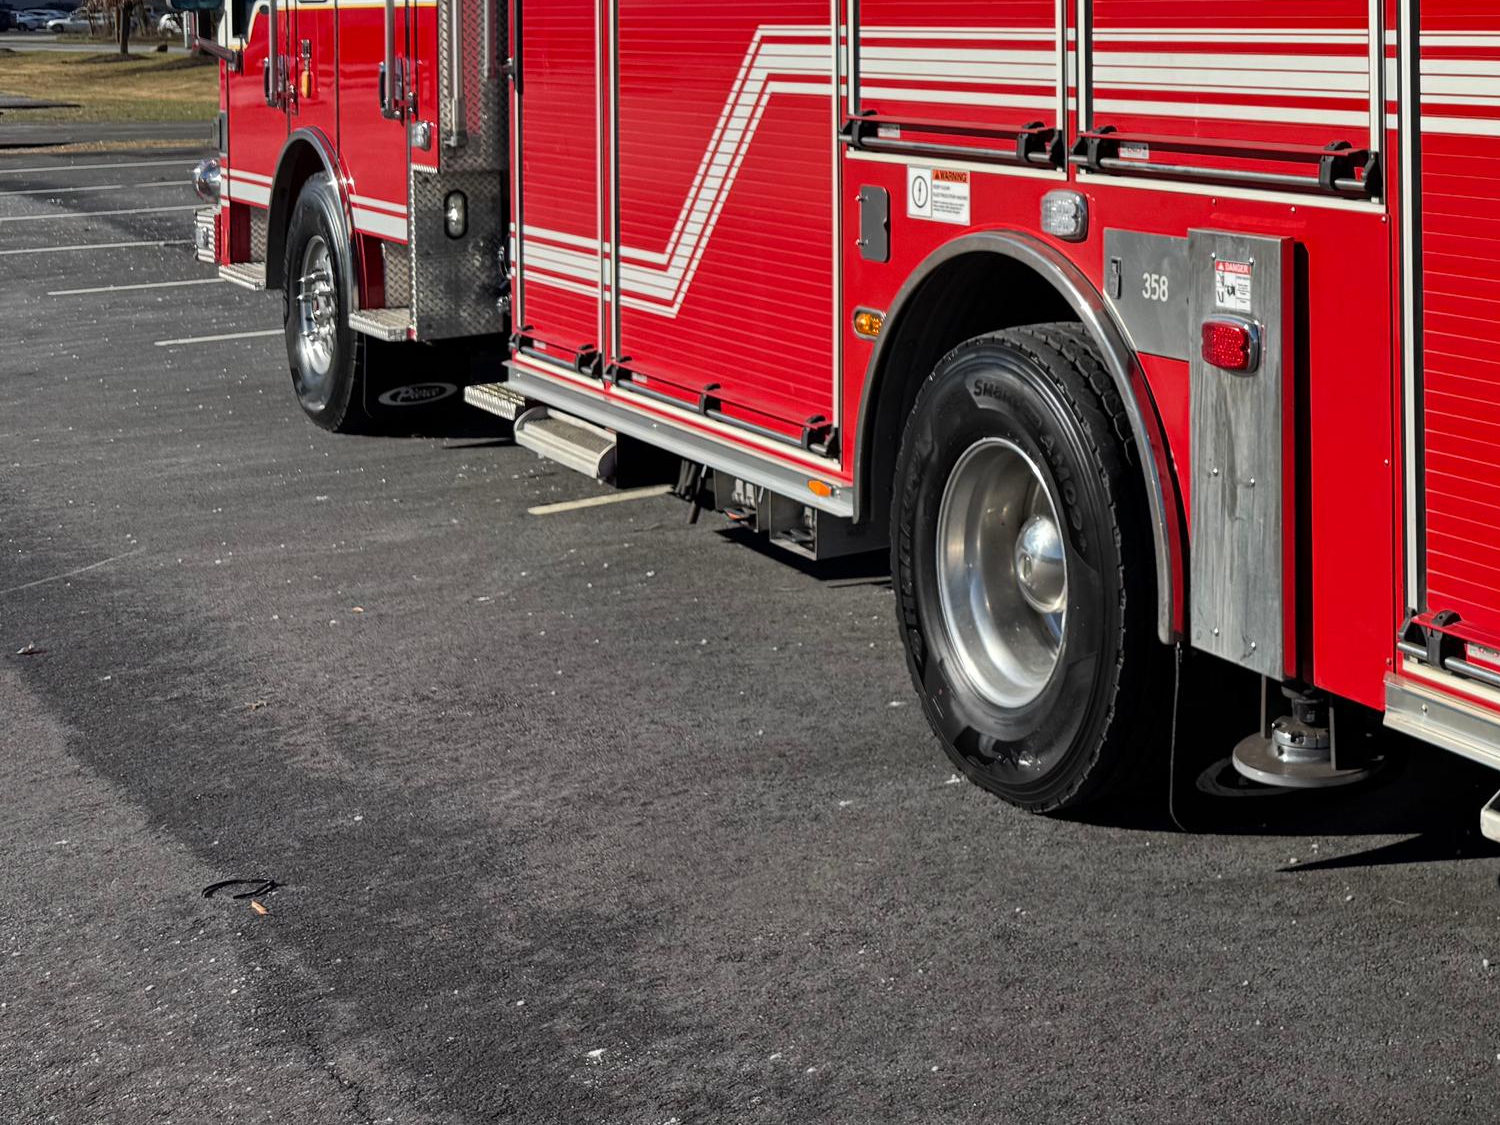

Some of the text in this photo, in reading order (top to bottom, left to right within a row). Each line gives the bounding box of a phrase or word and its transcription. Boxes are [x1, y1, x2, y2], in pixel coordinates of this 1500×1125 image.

[939, 170, 968, 183] WARNING
[1224, 262, 1249, 274] DANGER
[1142, 272, 1169, 302] 358
